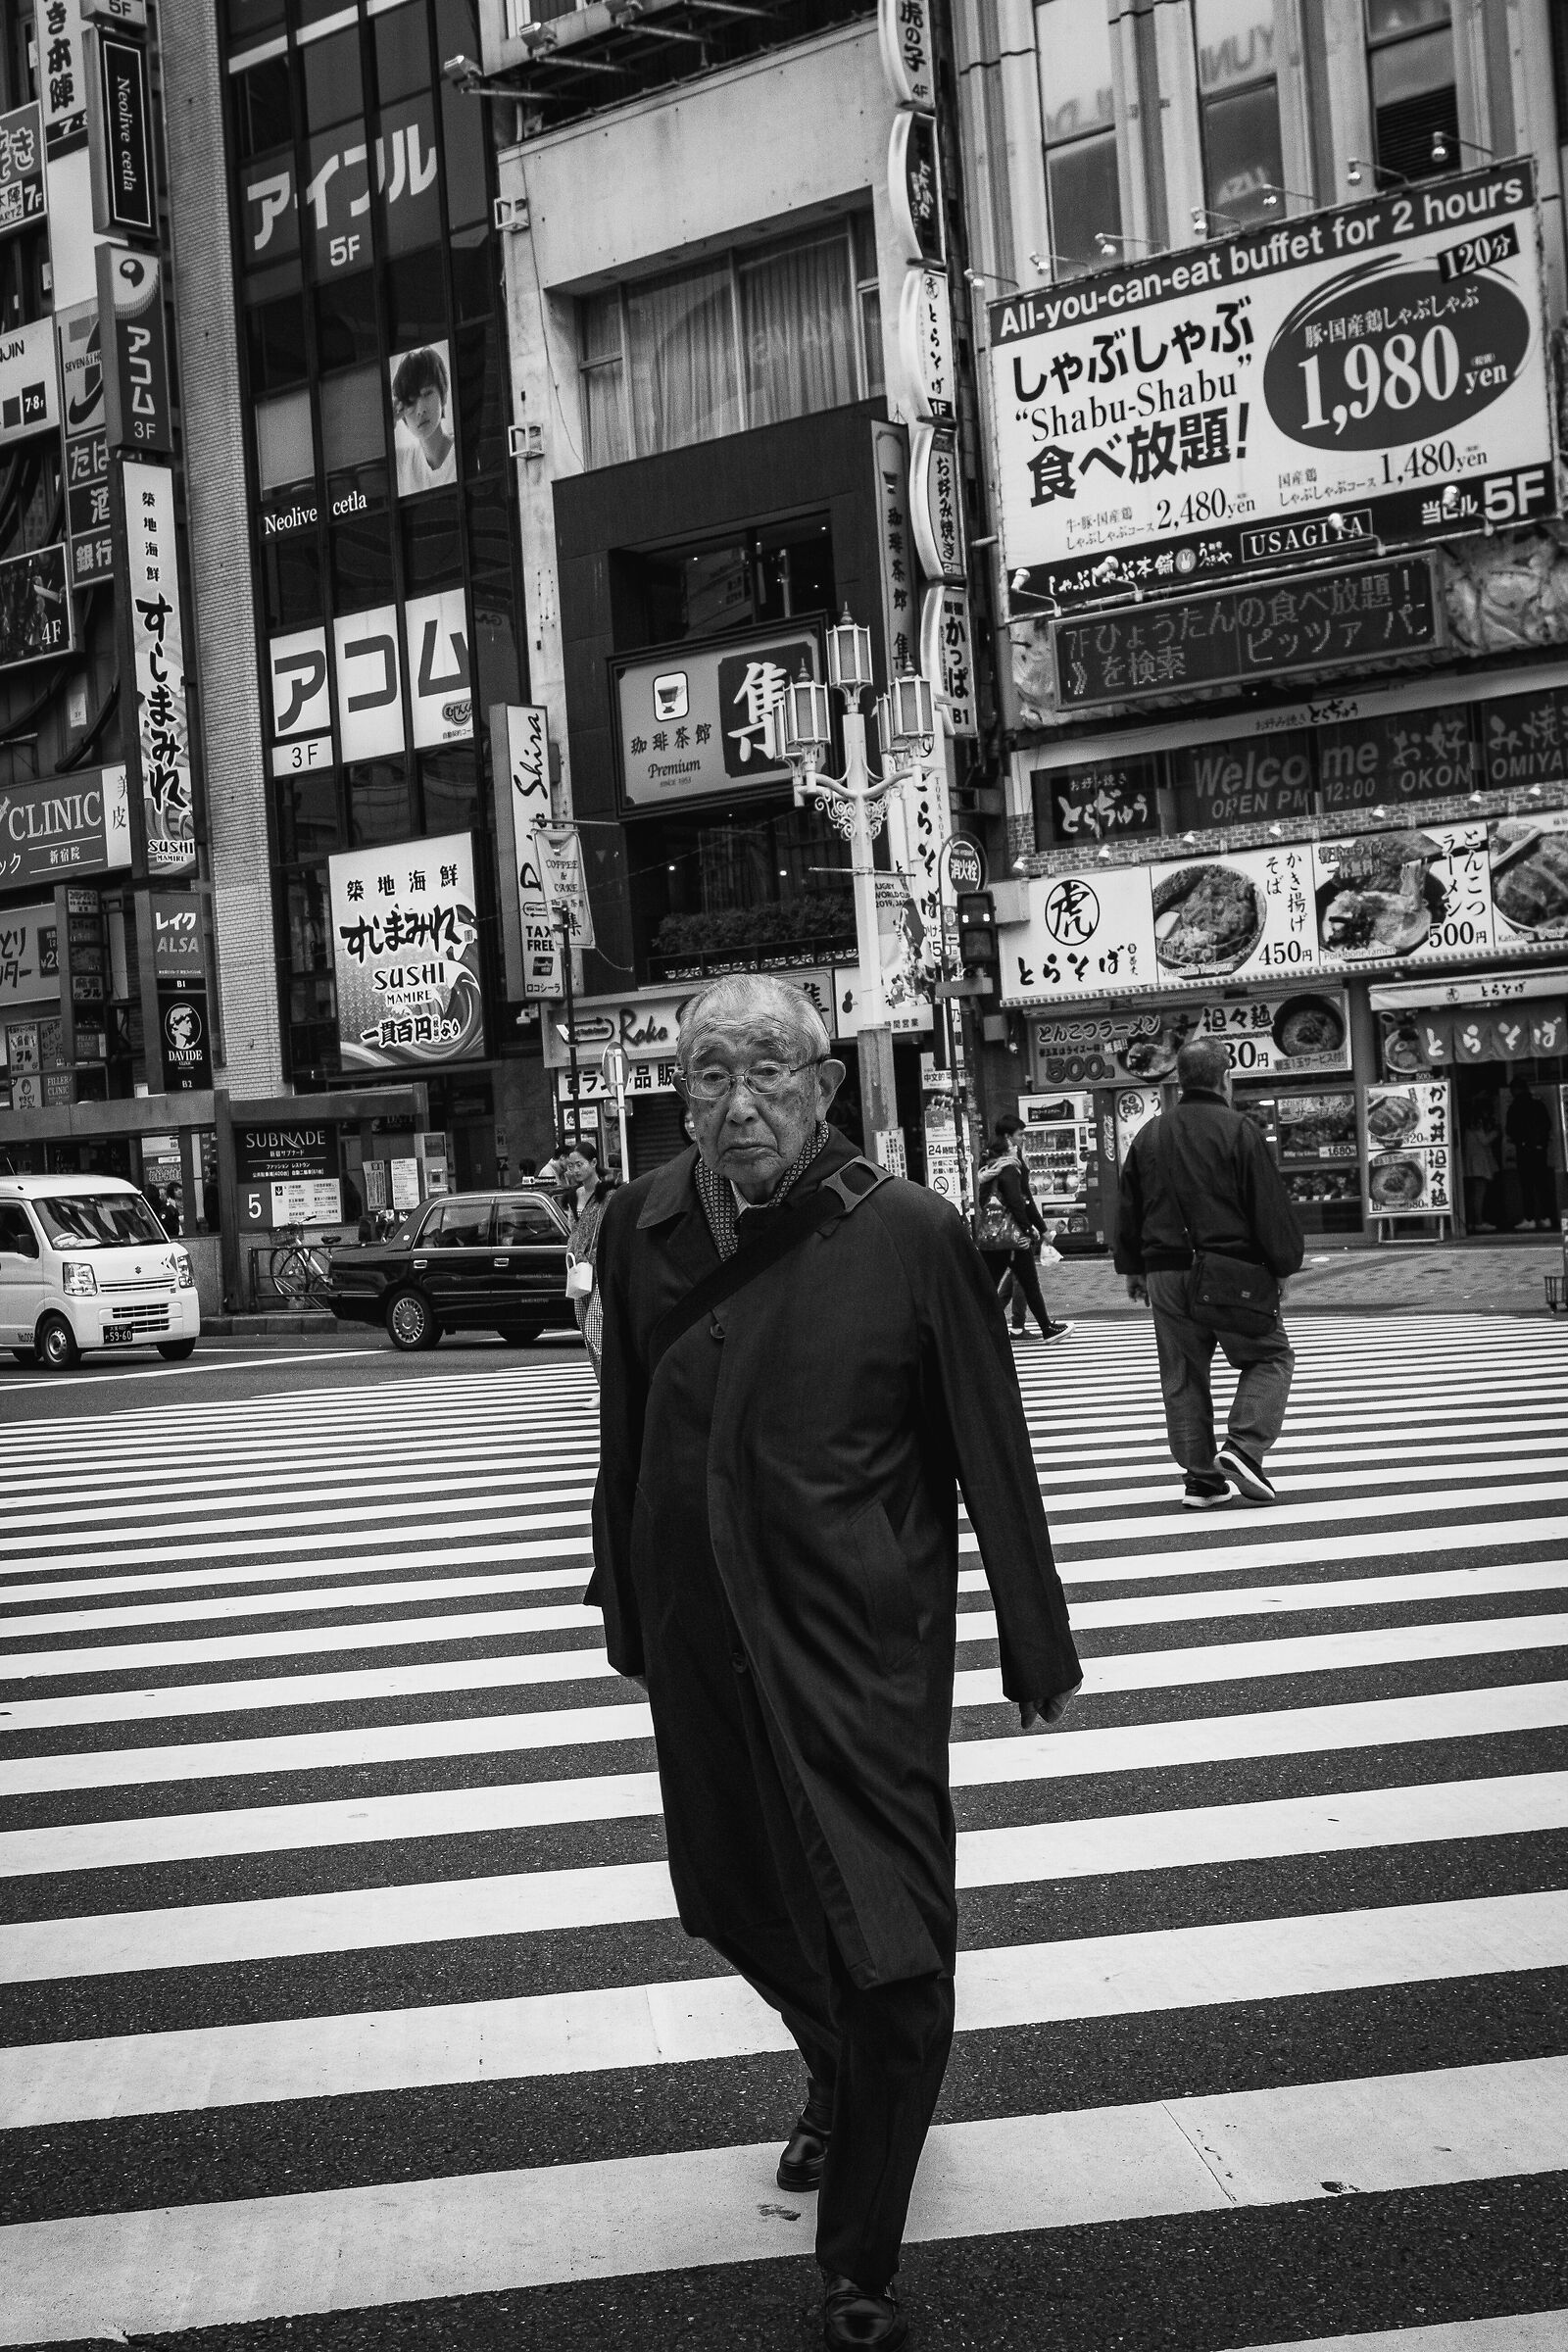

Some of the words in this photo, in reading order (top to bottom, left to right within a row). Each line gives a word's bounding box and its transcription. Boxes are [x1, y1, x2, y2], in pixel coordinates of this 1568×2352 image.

[116, 75, 133, 143] Neolive
[912, 83, 930, 98] 4F
[122, 150, 137, 192] cetla
[247, 124, 437, 251] アイフル
[24, 183, 43, 212] 7F
[329, 234, 361, 267] 5F
[1000, 253, 1223, 338] All-you-can-eat
[1229, 225, 1325, 275] buffet
[1332, 215, 1381, 249] for
[1392, 200, 1415, 234] 2
[1424, 176, 1524, 225] hours
[1444, 233, 1512, 280] 120分
[1012, 295, 1255, 403] しゃぶしゃぶ
[126, 325, 156, 416] アコム
[1298, 323, 1460, 436] 1,980
[1464, 364, 1508, 396] yen
[931, 401, 948, 416] 1F
[134, 421, 157, 440] 3F
[1026, 402, 1250, 509] 食べ放題!
[1380, 439, 1456, 485] 1,480
[1456, 451, 1489, 473] yen
[264, 506, 318, 535] Neolive
[332, 490, 368, 516] cetla
[1155, 487, 1227, 532] 2,480
[1226, 498, 1256, 519] yen
[1483, 469, 1546, 521] 5F
[75, 538, 113, 572] 銀行
[141, 491, 161, 582] 築地海鮮
[41, 618, 63, 645] 4F
[273, 617, 471, 733] アコム
[945, 616, 969, 700] かっぱ
[134, 591, 189, 813] すしまみれ
[953, 708, 969, 725] B1
[291, 743, 319, 768] 3F
[630, 722, 712, 757] 珈琲茶館
[1393, 704, 1568, 767] お好み焼
[513, 711, 550, 801] Shira
[647, 758, 702, 779] Premium
[1399, 748, 1568, 793] OKONOMIYA
[8, 790, 103, 842] CLINIC
[1211, 792, 1269, 819] OPEN
[1277, 789, 1307, 809] PM
[1325, 777, 1376, 803] 12:00
[49, 845, 81, 865] 新宿院
[148, 837, 195, 855] SUSHI
[545, 858, 579, 871] COFFEE
[346, 863, 459, 903] 築地海鮮
[553, 882, 579, 894] CAKE
[875, 881, 896, 892] UGBY
[950, 858, 978, 883] 消火栓
[1264, 856, 1283, 896] そば
[1442, 832, 1463, 918] ラーメン
[1463, 829, 1487, 916] とんこつ
[1049, 881, 1095, 940] 虎
[1286, 851, 1307, 933] かき揚げ
[155, 911, 196, 931] レイク
[339, 903, 464, 964] すしまみれ
[524, 924, 552, 939] TAX
[1428, 920, 1488, 950] 500円
[157, 937, 200, 954] ALSA
[526, 938, 556, 953] FREE
[1017, 944, 1125, 987] とらそば
[1258, 940, 1313, 966] 450円
[373, 961, 445, 992] SUSHI
[526, 982, 561, 994] ロコシーラ
[1481, 980, 1527, 998] とらそば
[386, 989, 433, 1005] MAMIRE
[618, 1007, 668, 1047] Roko
[1038, 1013, 1161, 1044] とんこつラーメン
[1426, 1015, 1563, 1056] とらそば
[168, 1049, 203, 1061] DAVIDE
[181, 1079, 193, 1089] B2
[1428, 1085, 1447, 1144] かつ丼
[245, 1130, 326, 1149] SUBNADE
[248, 1193, 263, 1219] 5
